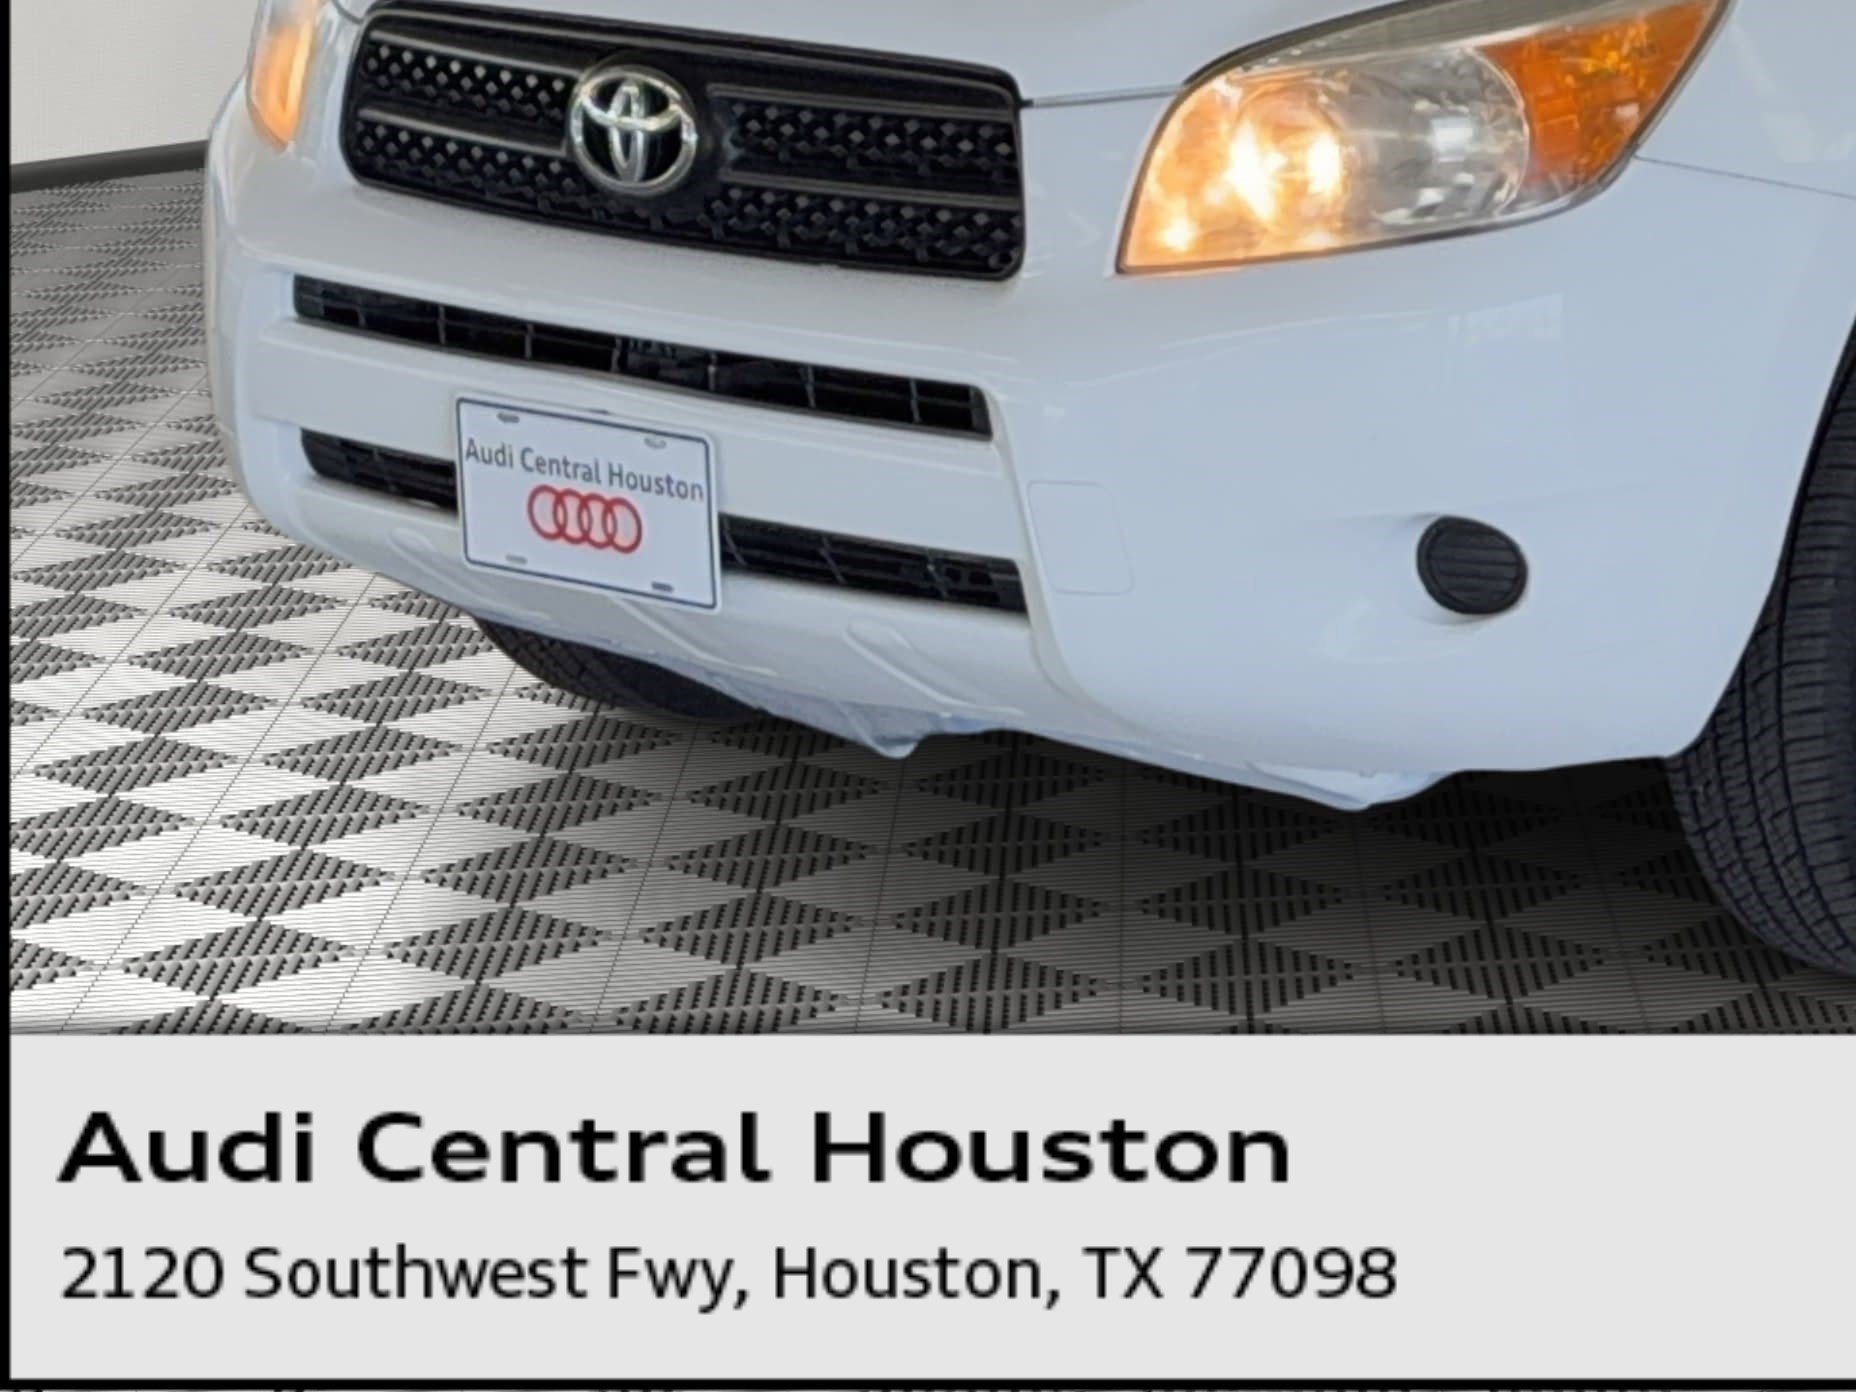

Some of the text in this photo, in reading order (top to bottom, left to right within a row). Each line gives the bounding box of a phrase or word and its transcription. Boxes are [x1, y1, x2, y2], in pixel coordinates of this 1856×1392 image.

[465, 437, 704, 502] Audi Central Houston
